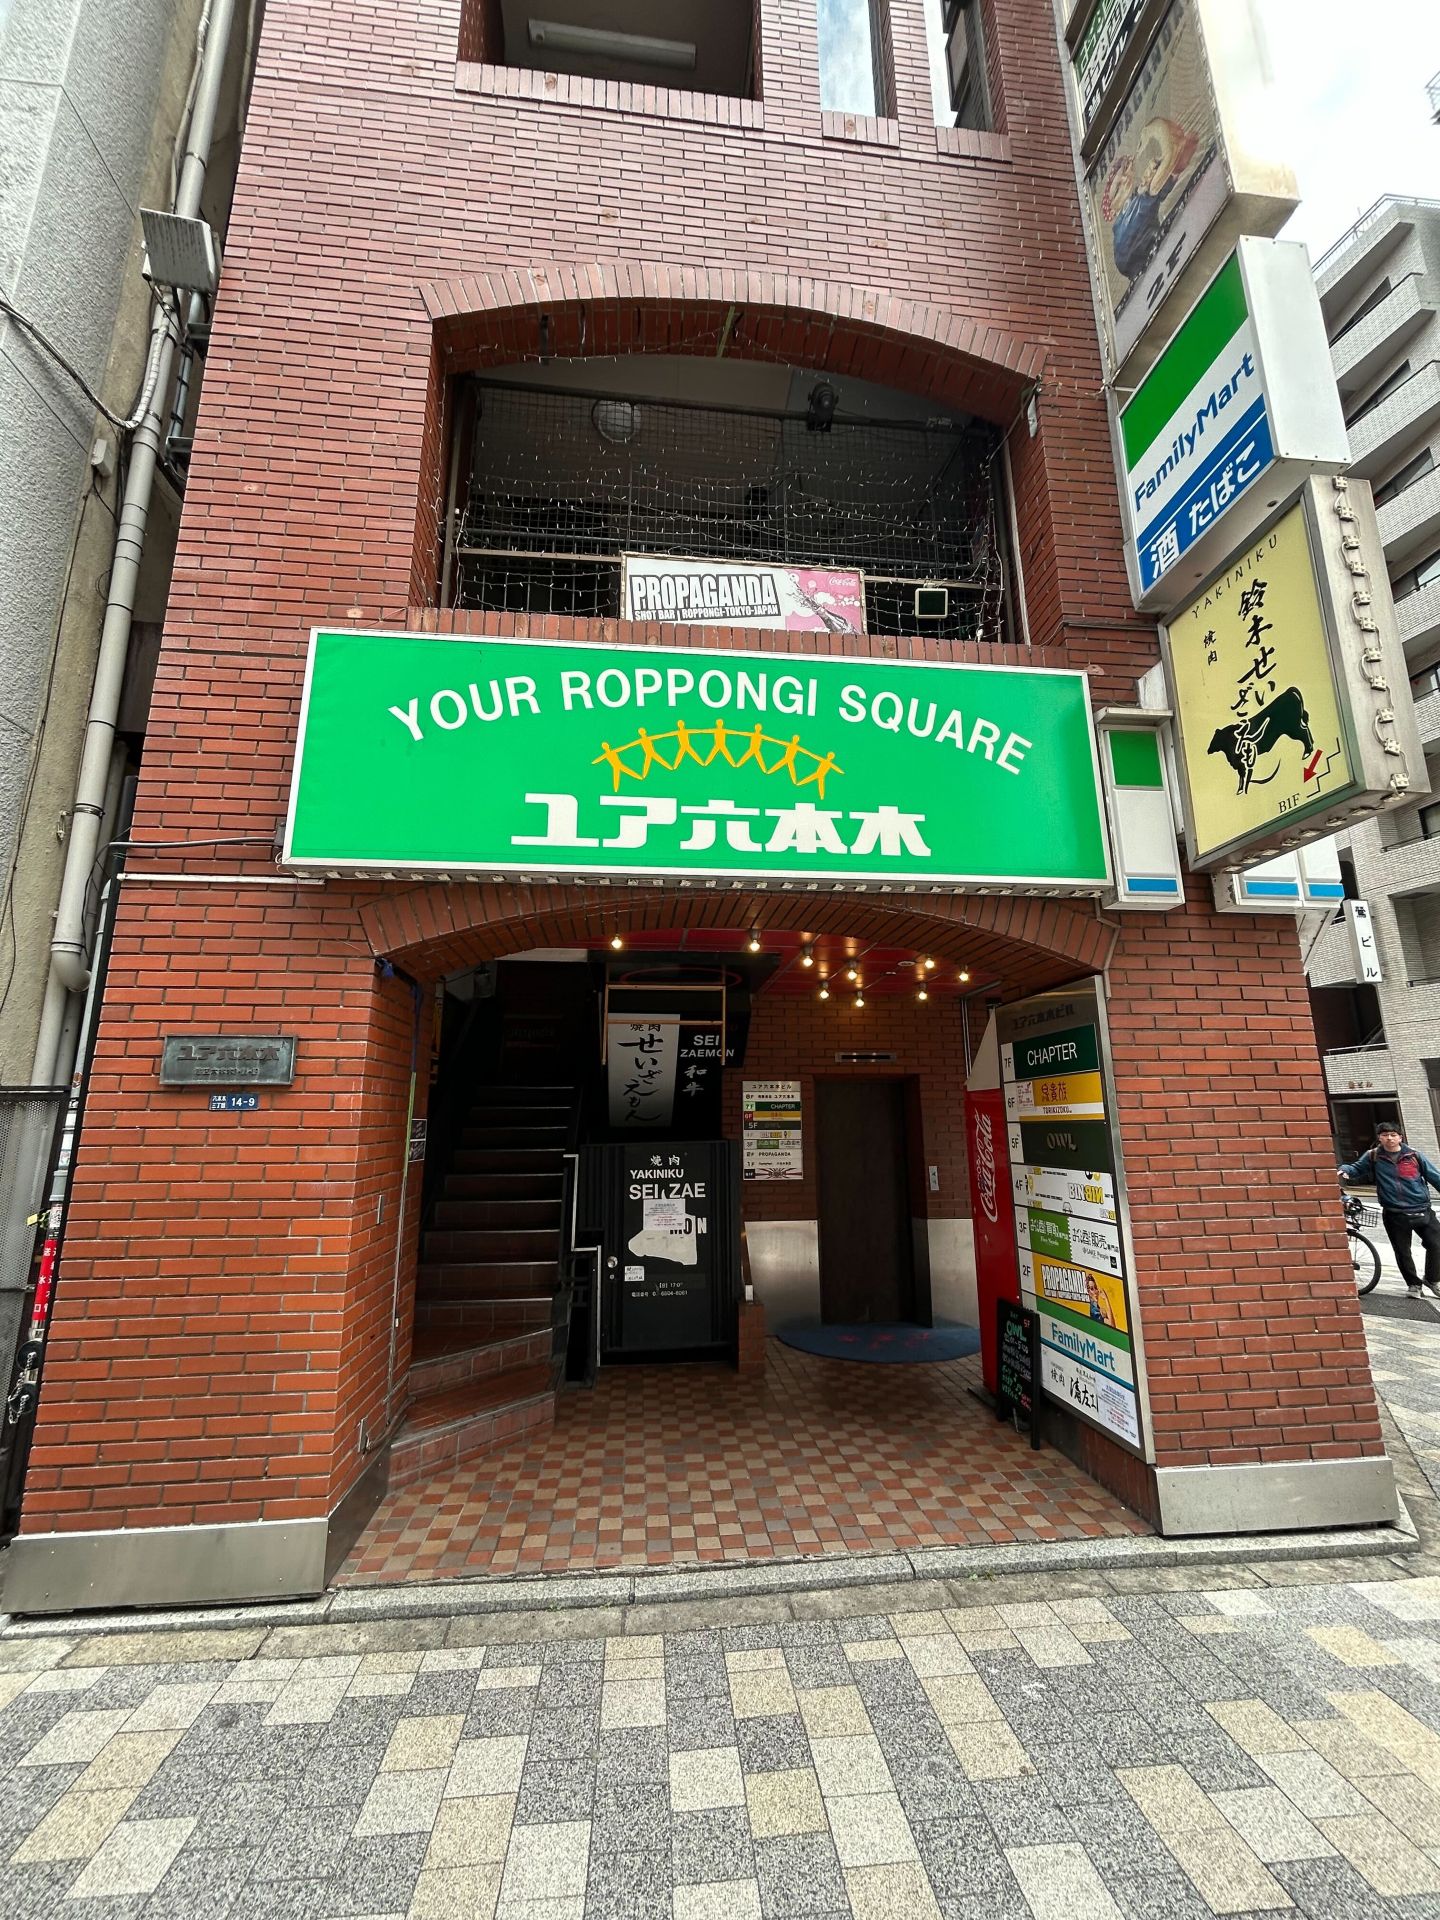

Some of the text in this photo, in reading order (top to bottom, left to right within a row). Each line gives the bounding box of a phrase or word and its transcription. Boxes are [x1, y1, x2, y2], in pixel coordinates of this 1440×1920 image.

[1146, 231, 1187, 309] 2F
[1134, 351, 1255, 512] FamilyMart
[1150, 439, 1262, 579] 酒 たばこ
[1191, 534, 1279, 619] YAKINIKU
[631, 574, 778, 611] PROPAGANDA
[634, 605, 779, 621] SHOT BAR ROPPONGI-TOKYO-JAPAN
[388, 668, 1034, 776] YOUR ROPPONGI SQUARE
[1278, 793, 1301, 813] B1F
[511, 793, 932, 857] ユア六本木
[693, 1034, 720, 1046] SEI
[176, 1045, 280, 1062] ユア六本木
[1003, 1042, 1078, 1069] 7F CHAPTER
[682, 1064, 708, 1097] 和牛
[231, 1097, 256, 1107] 14-9
[1007, 1097, 1016, 1108] 6F
[1011, 1132, 1078, 1152] 5F OWL
[650, 1155, 681, 1167] 焼肉
[974, 1107, 998, 1223] Coca-Cola
[630, 1168, 684, 1180] YAKINIKU
[1015, 1178, 1023, 1190] 4F
[629, 1182, 706, 1200] SEI ZAE
[1018, 1222, 1028, 1234] 3F
[33, 1248, 52, 1313] 送水口
[1022, 1264, 1031, 1277] 2F
[1051, 1323, 1116, 1372] FamilyMart
